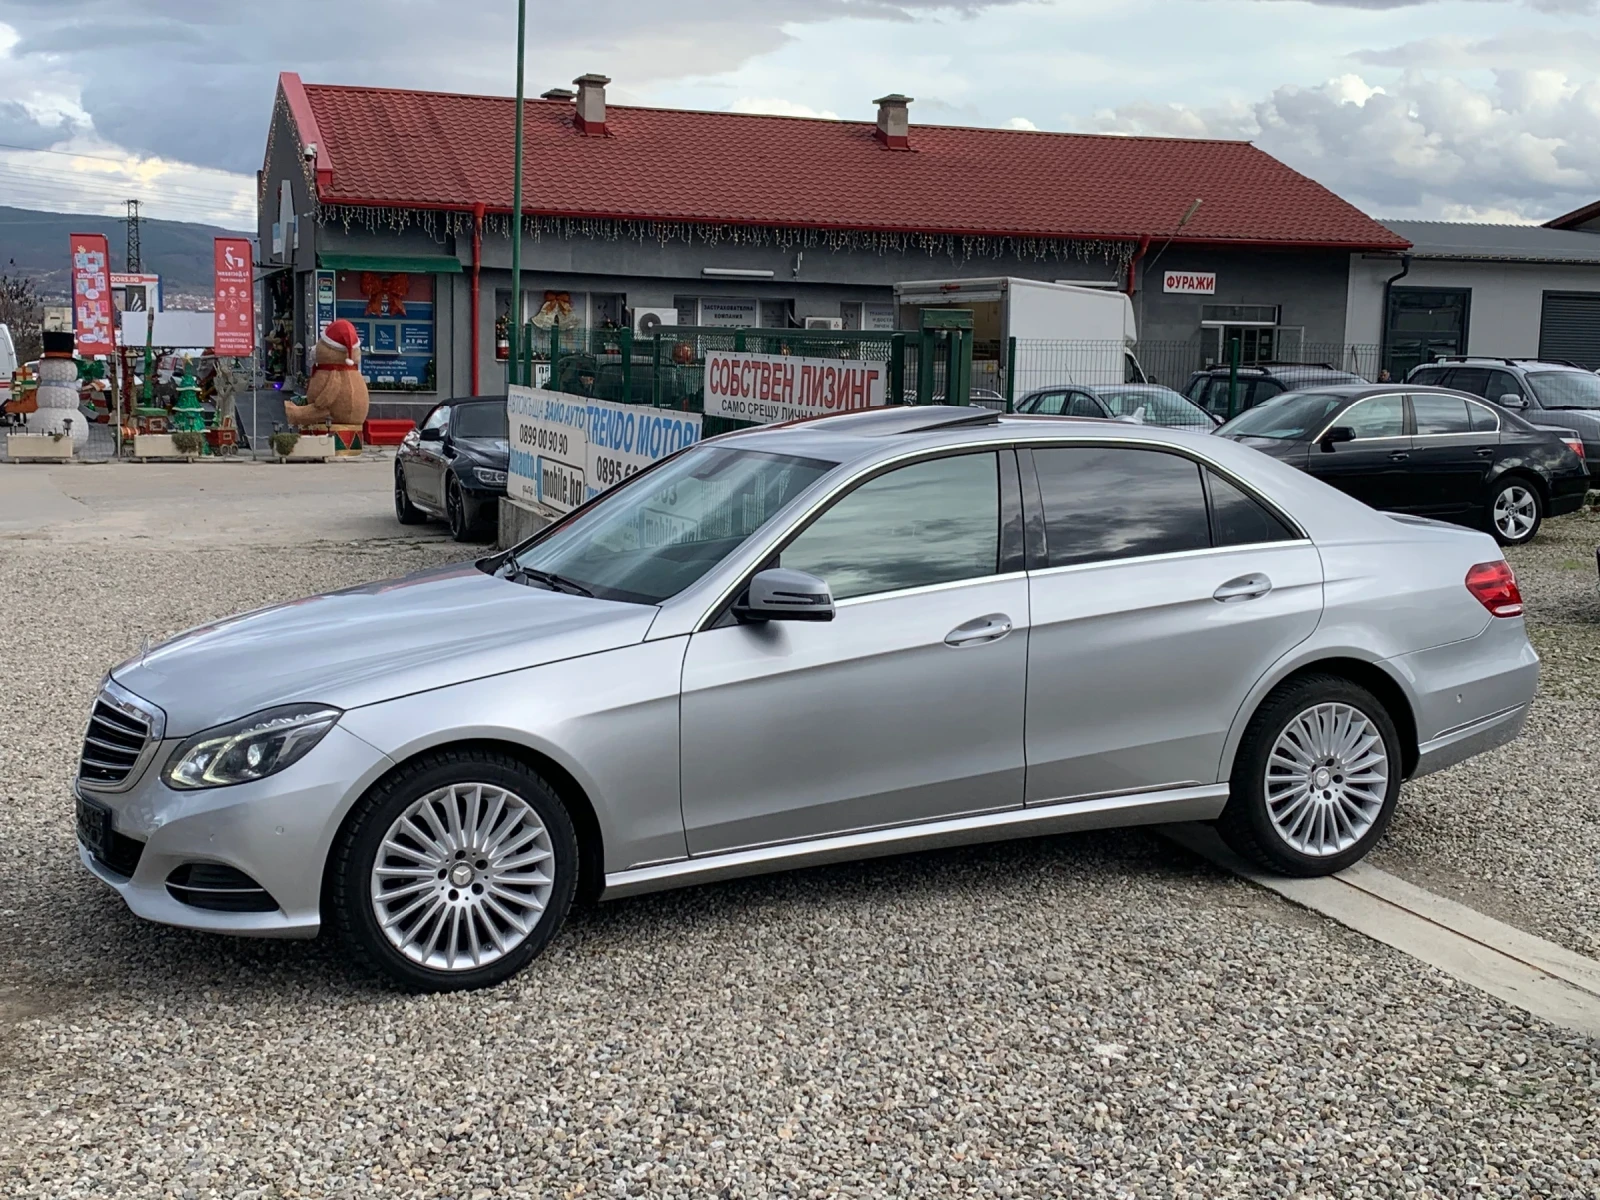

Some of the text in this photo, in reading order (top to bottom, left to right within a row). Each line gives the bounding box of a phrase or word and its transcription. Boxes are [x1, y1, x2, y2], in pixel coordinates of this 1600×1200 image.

[1166, 275, 1214, 290] ФУРАЖИ
[709, 357, 879, 410] СОБСТВЕН ЛИЗИНГ
[721, 399, 746, 414] САМО
[747, 402, 779, 420] СРЕЩУ
[519, 423, 568, 456] 0899 00 90 90
[587, 405, 634, 453] TRENDO
[596, 455, 622, 485] 0895
